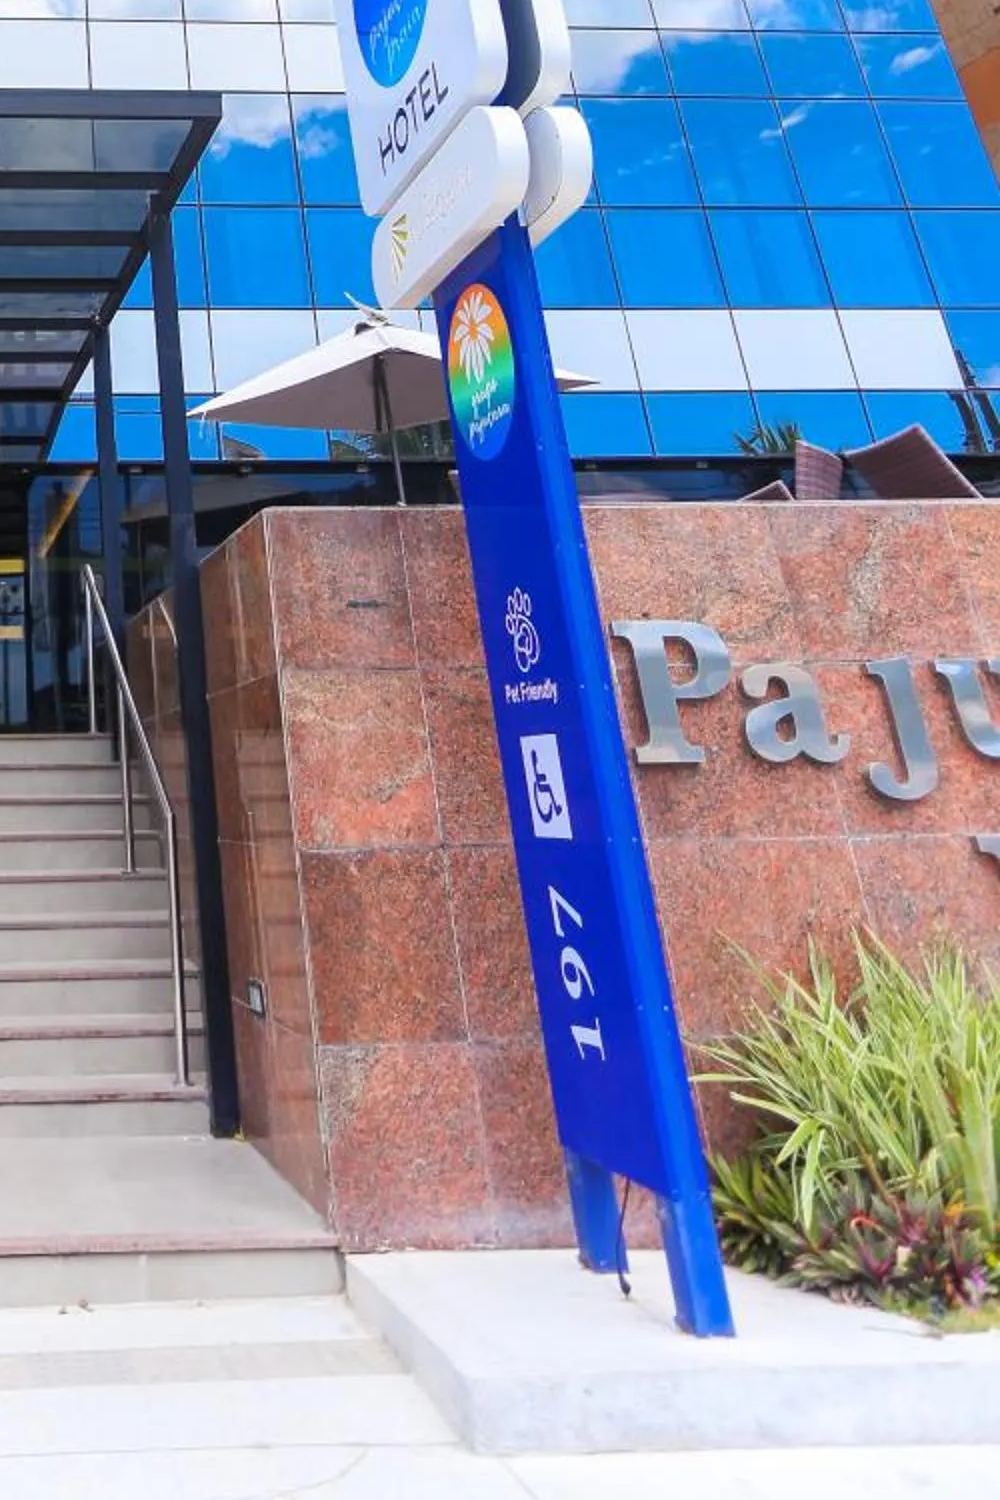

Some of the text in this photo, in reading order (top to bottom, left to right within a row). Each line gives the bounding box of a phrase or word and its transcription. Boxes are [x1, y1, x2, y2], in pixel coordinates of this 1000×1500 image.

[377, 60, 449, 177] HOTEL
[505, 678, 558, 705] Pet Friendly
[547, 884, 606, 1062] 197
